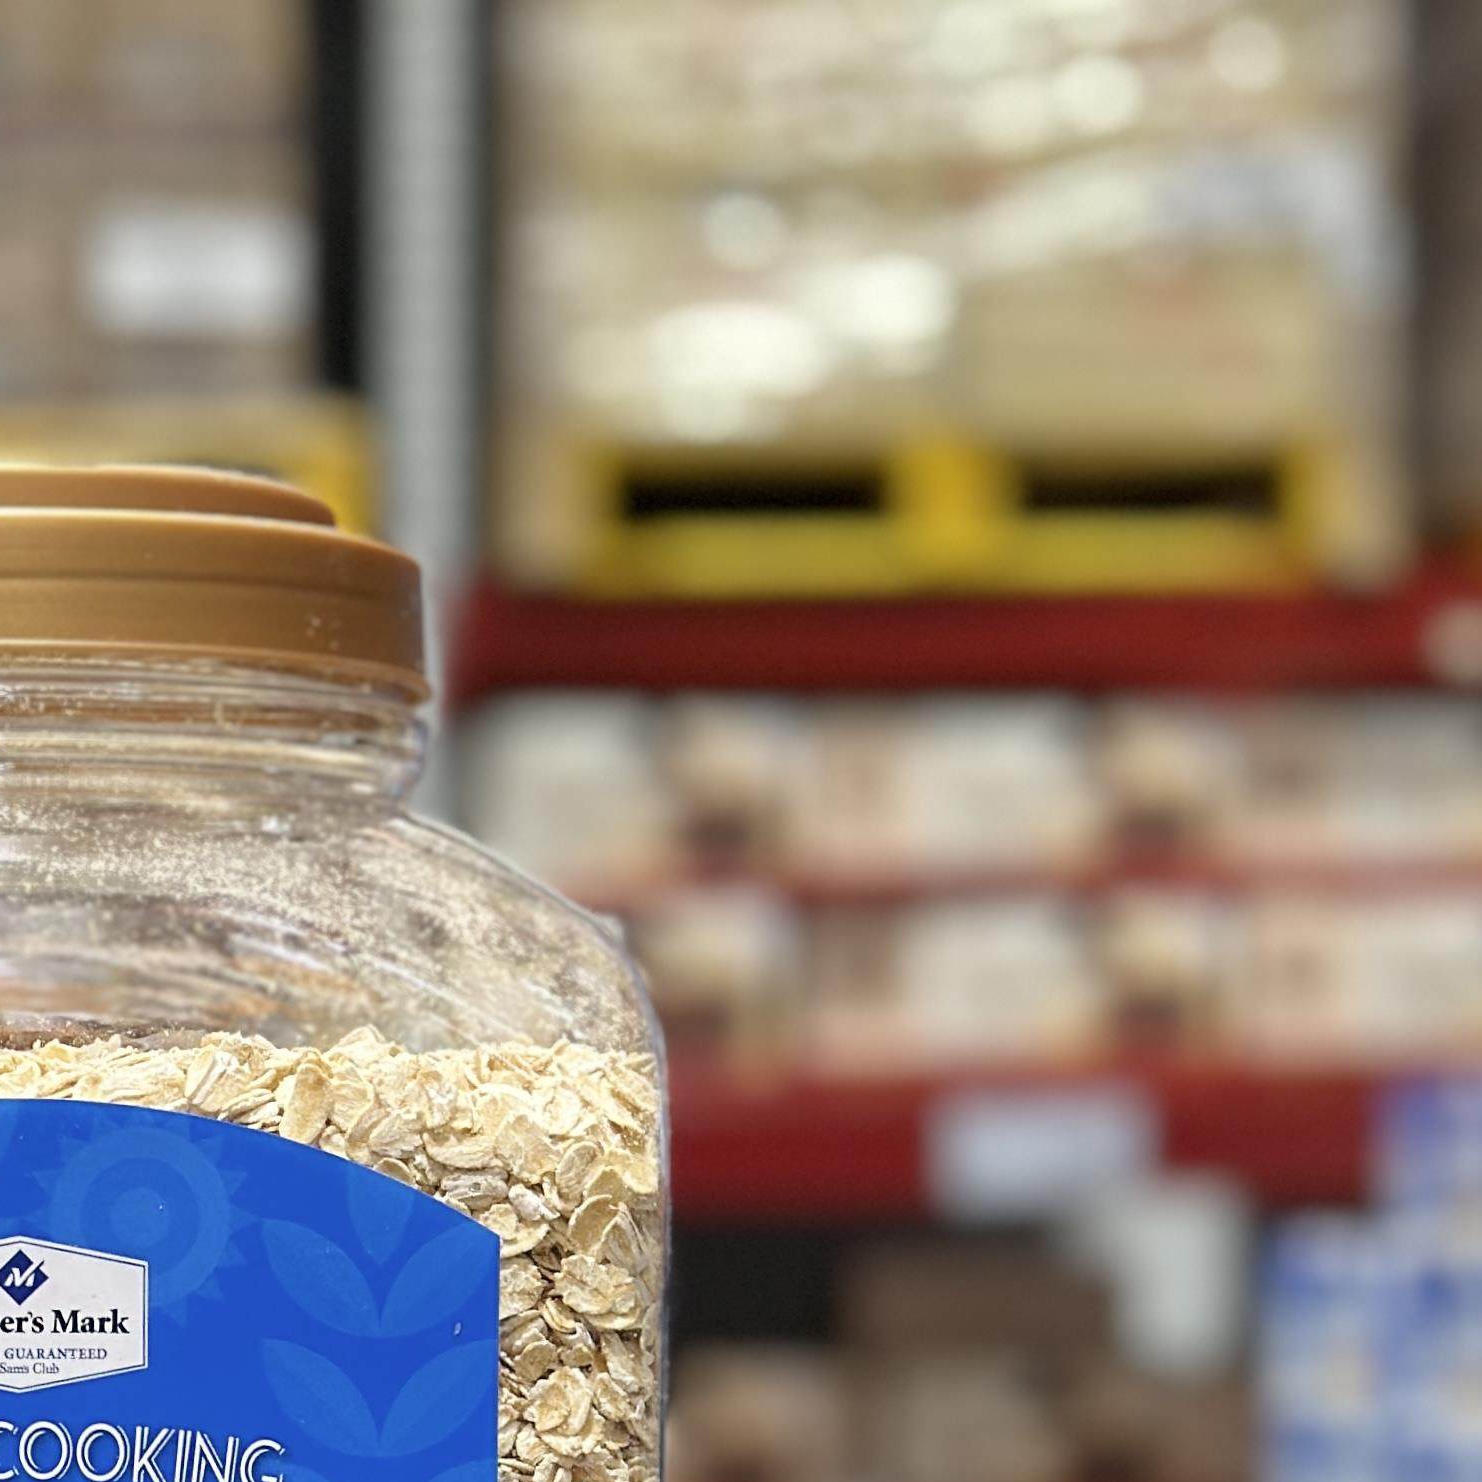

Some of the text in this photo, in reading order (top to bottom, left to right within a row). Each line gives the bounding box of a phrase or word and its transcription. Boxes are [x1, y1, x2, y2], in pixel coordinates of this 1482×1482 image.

[51, 1309, 130, 1334] Mark
[4, 1348, 108, 1360] GUARANTEED
[33, 1362, 59, 1374] Club
